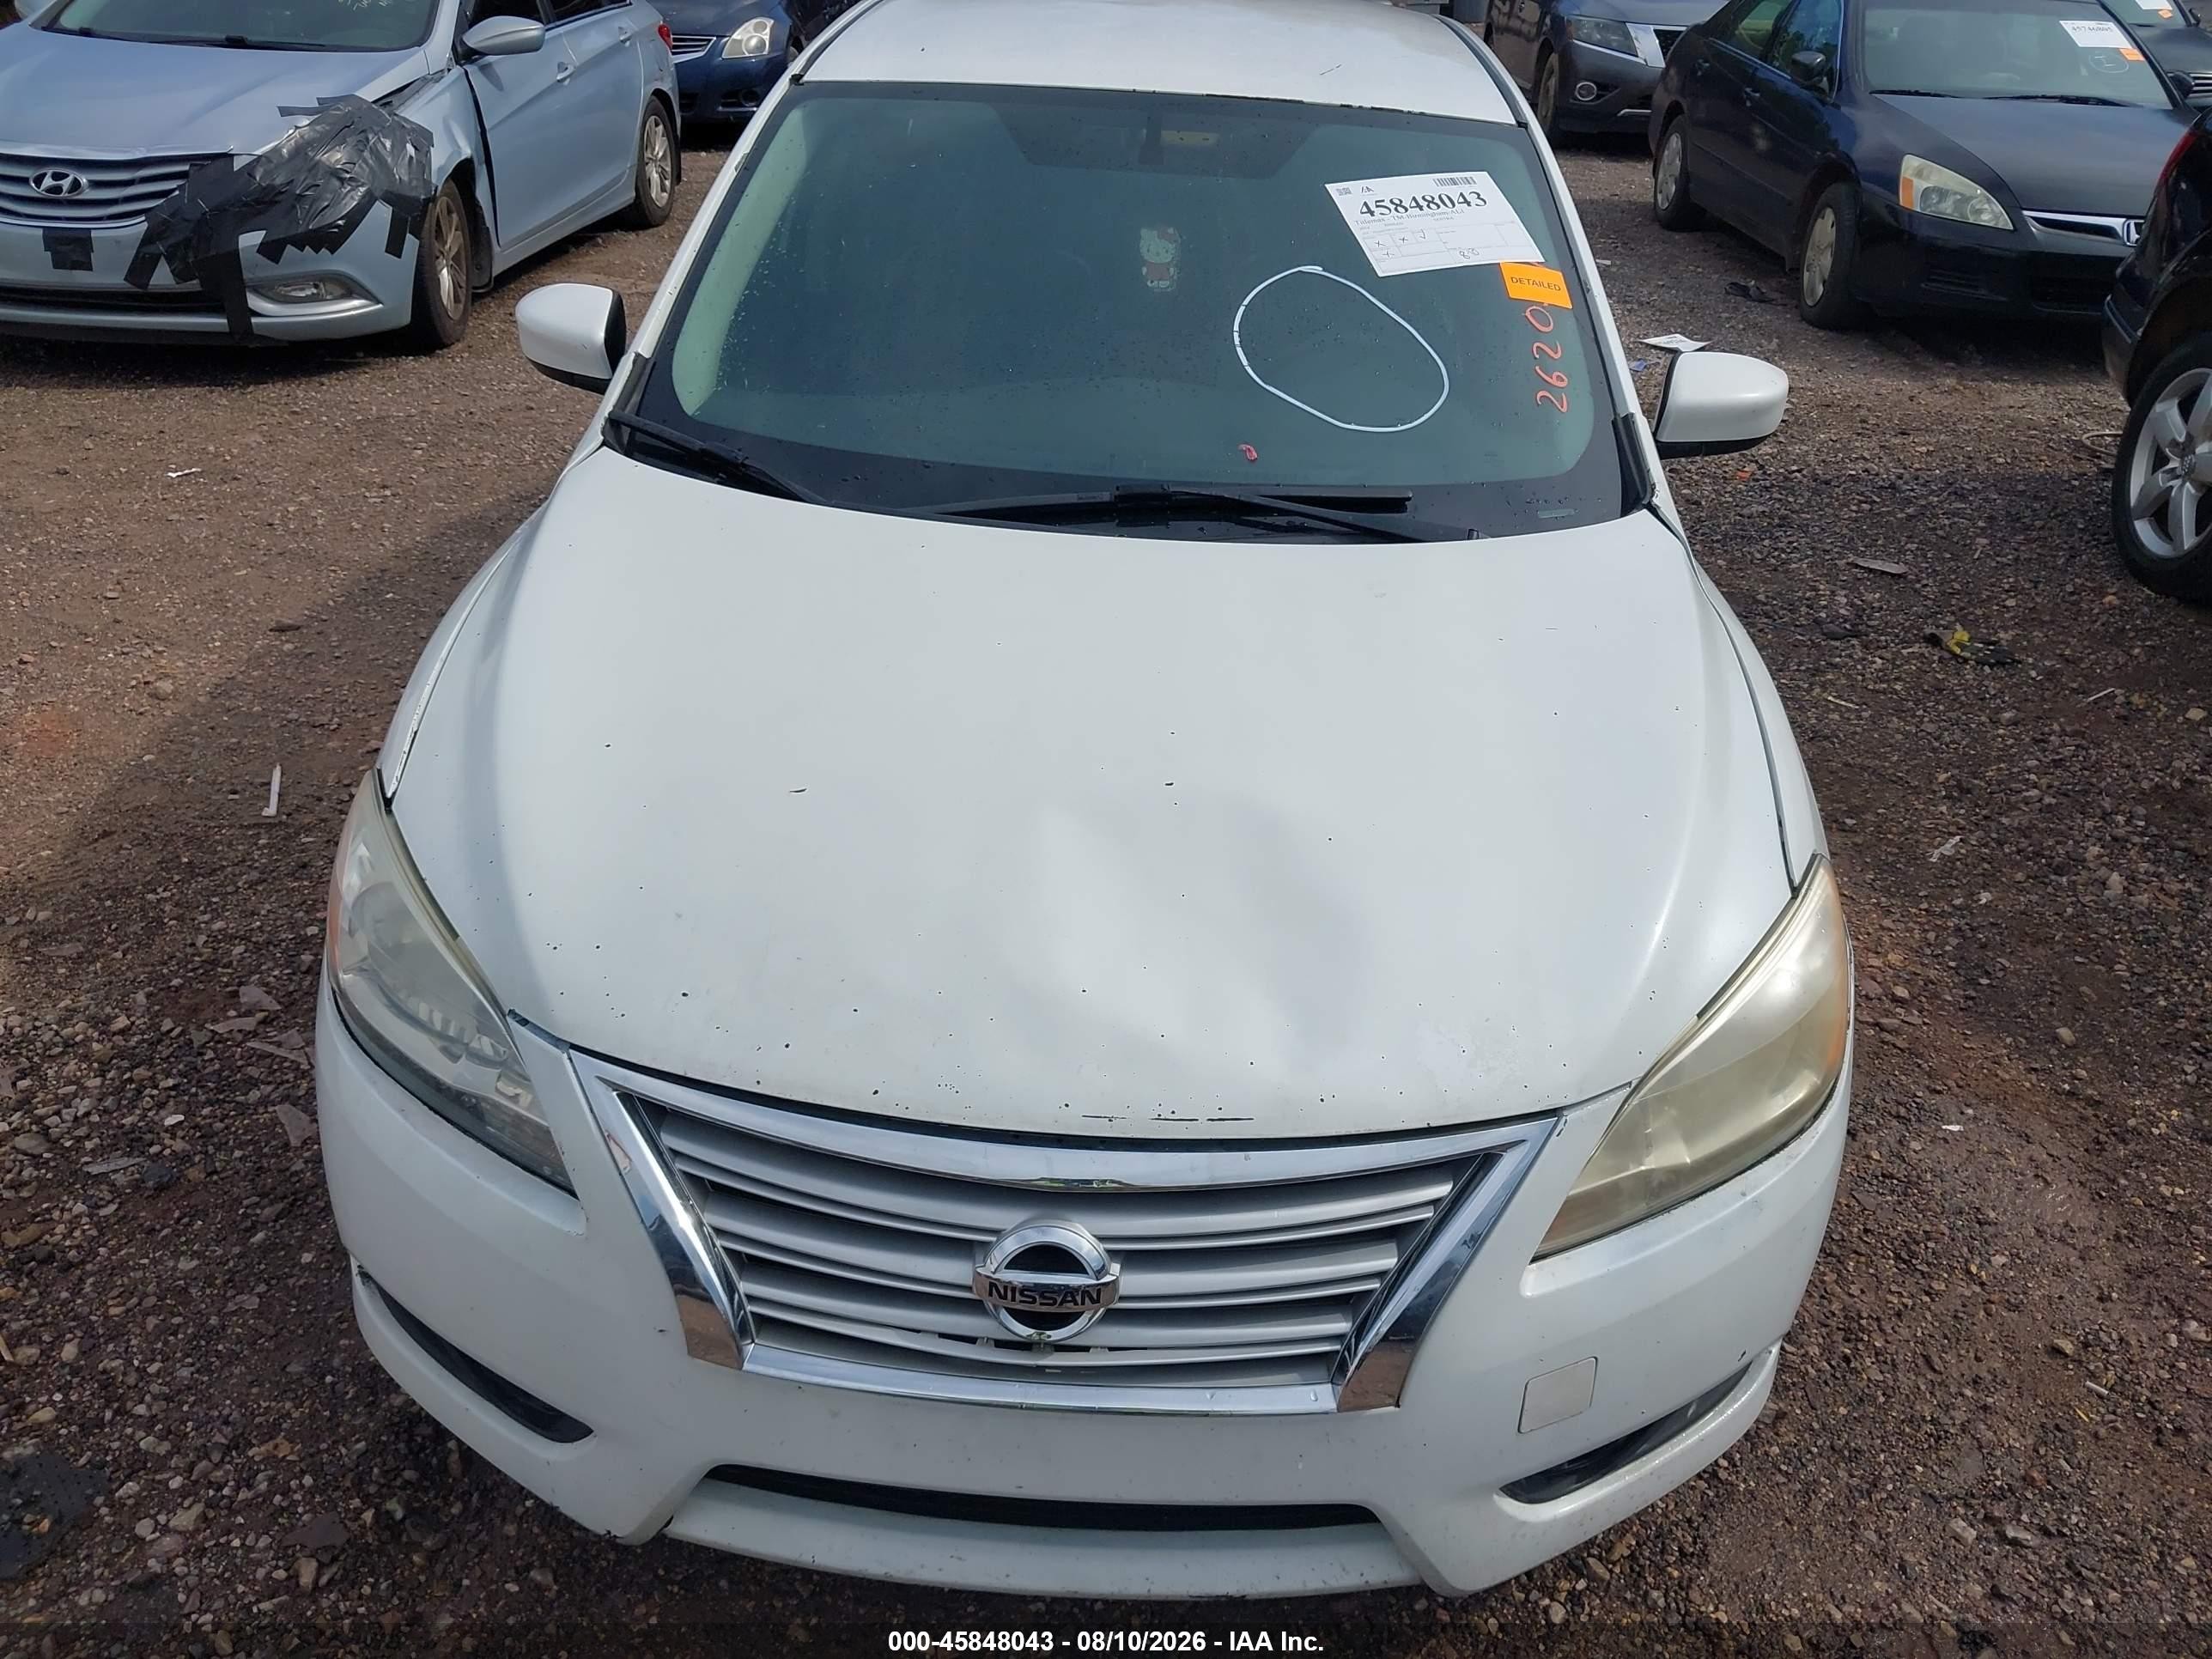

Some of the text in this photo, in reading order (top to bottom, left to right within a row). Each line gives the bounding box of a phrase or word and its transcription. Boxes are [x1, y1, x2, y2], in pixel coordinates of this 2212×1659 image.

[1359, 191, 1487, 217] 45848043
[1510, 276, 1561, 292] DETAILED
[1523, 305, 1569, 413] 2620
[988, 1281, 1102, 1307] NISSAN
